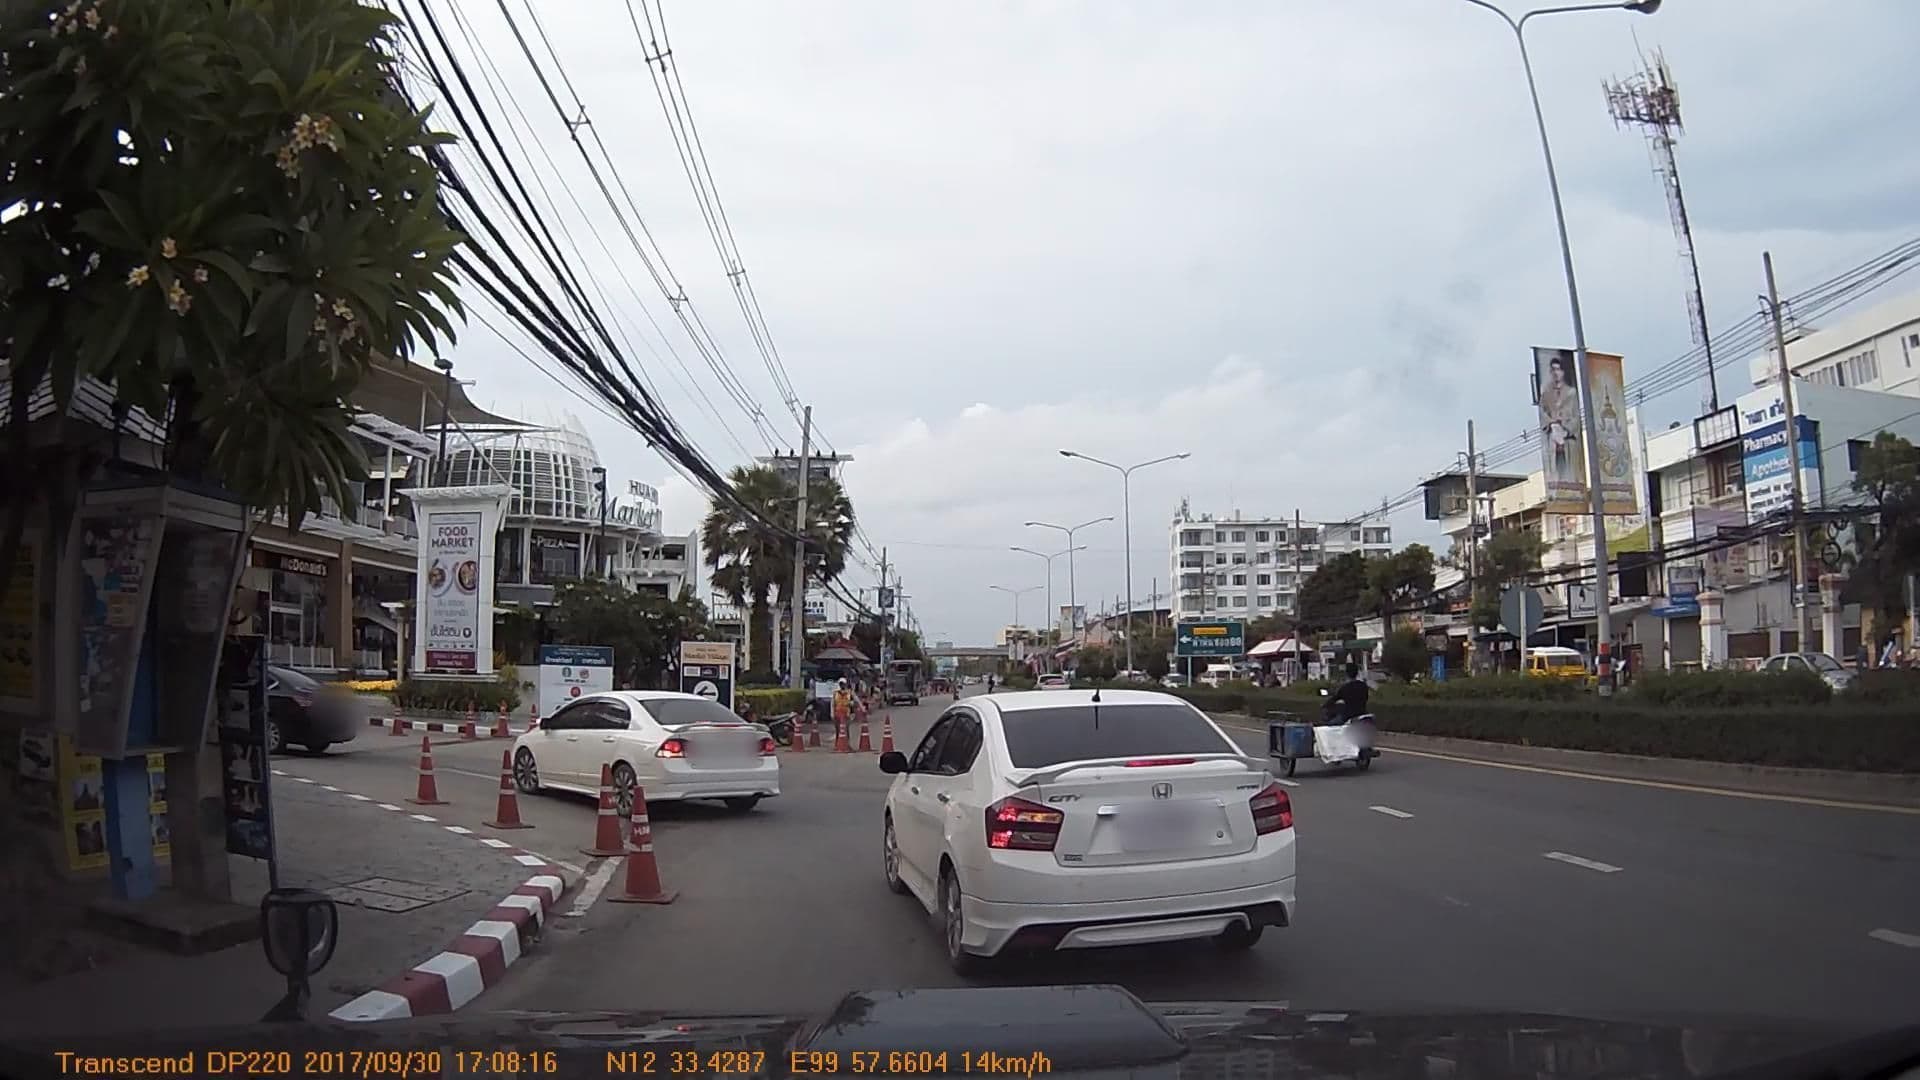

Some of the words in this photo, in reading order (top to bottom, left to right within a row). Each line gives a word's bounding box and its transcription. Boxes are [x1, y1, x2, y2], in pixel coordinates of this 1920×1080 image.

[1744, 429, 1788, 453] Pharmacy
[438, 526, 468, 536] FOOD
[431, 537, 474, 548] MARKET
